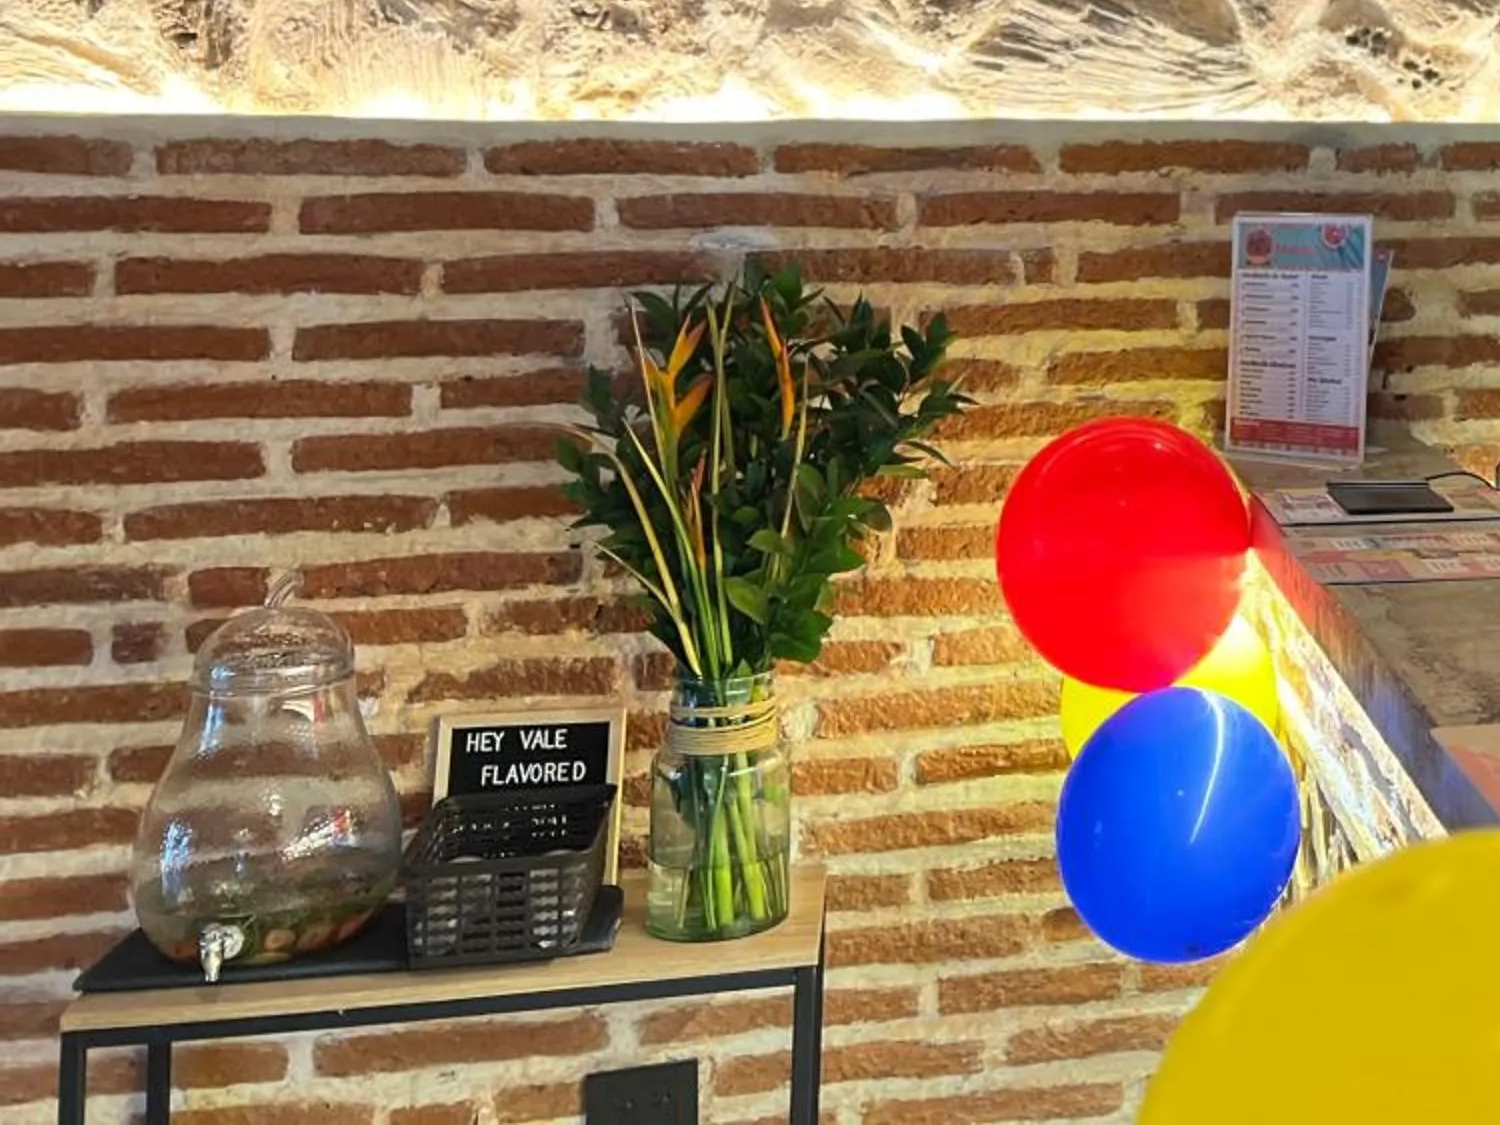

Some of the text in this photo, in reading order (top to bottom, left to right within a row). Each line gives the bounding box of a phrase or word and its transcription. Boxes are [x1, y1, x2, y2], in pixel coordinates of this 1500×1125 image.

[466, 728, 568, 753] HEY VALE
[481, 760, 587, 787] FLAVORED
